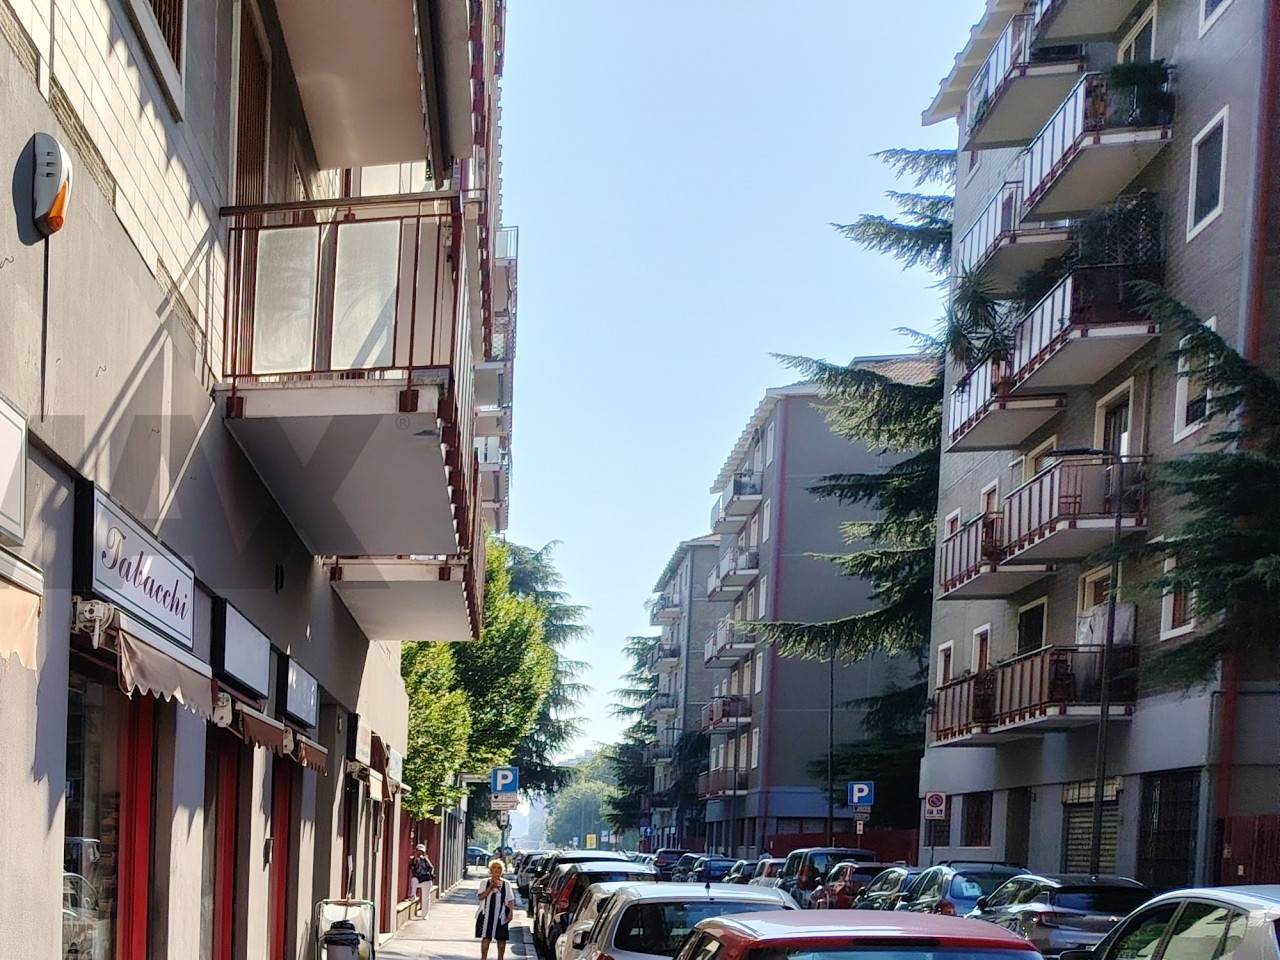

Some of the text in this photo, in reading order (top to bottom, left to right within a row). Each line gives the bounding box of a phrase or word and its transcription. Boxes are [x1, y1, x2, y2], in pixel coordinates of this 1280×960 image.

[101, 526, 189, 620] Tabacchi
[496, 769, 514, 791] P
[852, 783, 869, 803] P
